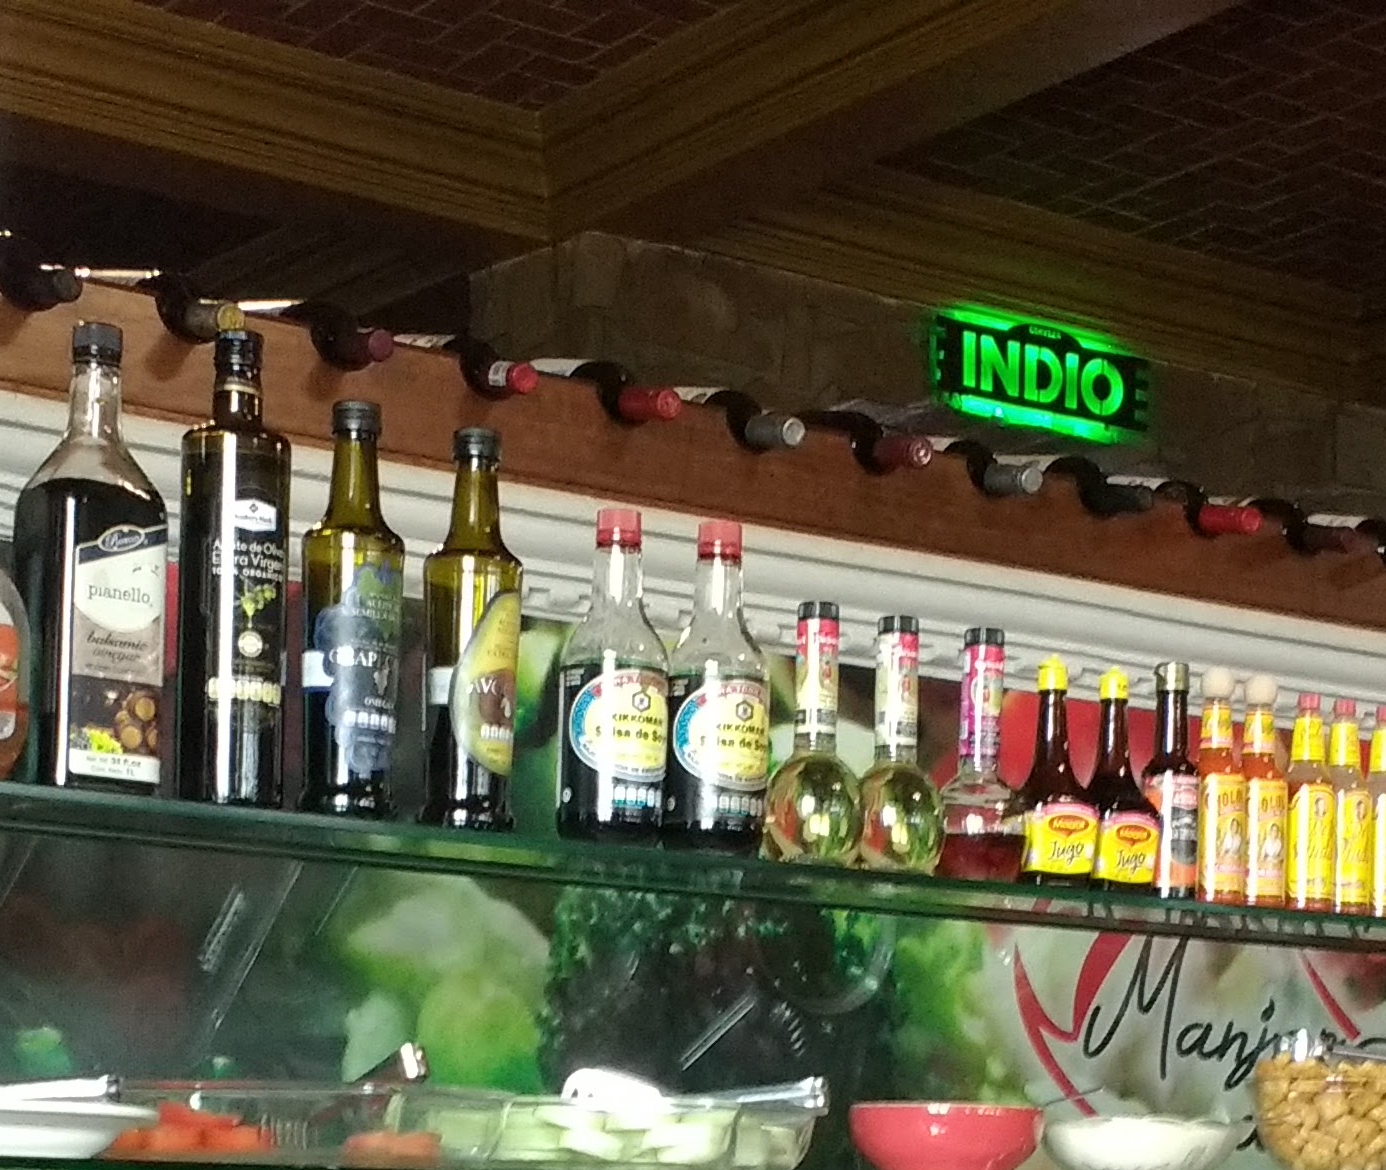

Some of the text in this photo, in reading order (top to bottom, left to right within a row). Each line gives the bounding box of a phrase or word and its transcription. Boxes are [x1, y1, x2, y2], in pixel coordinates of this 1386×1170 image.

[963, 330, 1124, 416] INDIO
[249, 541, 263, 553] de
[88, 584, 151, 605] pianello
[636, 729, 649, 740] de
[739, 738, 753, 750] de
[1049, 841, 1085, 867] Jugo
[1116, 850, 1147, 873] Jugo
